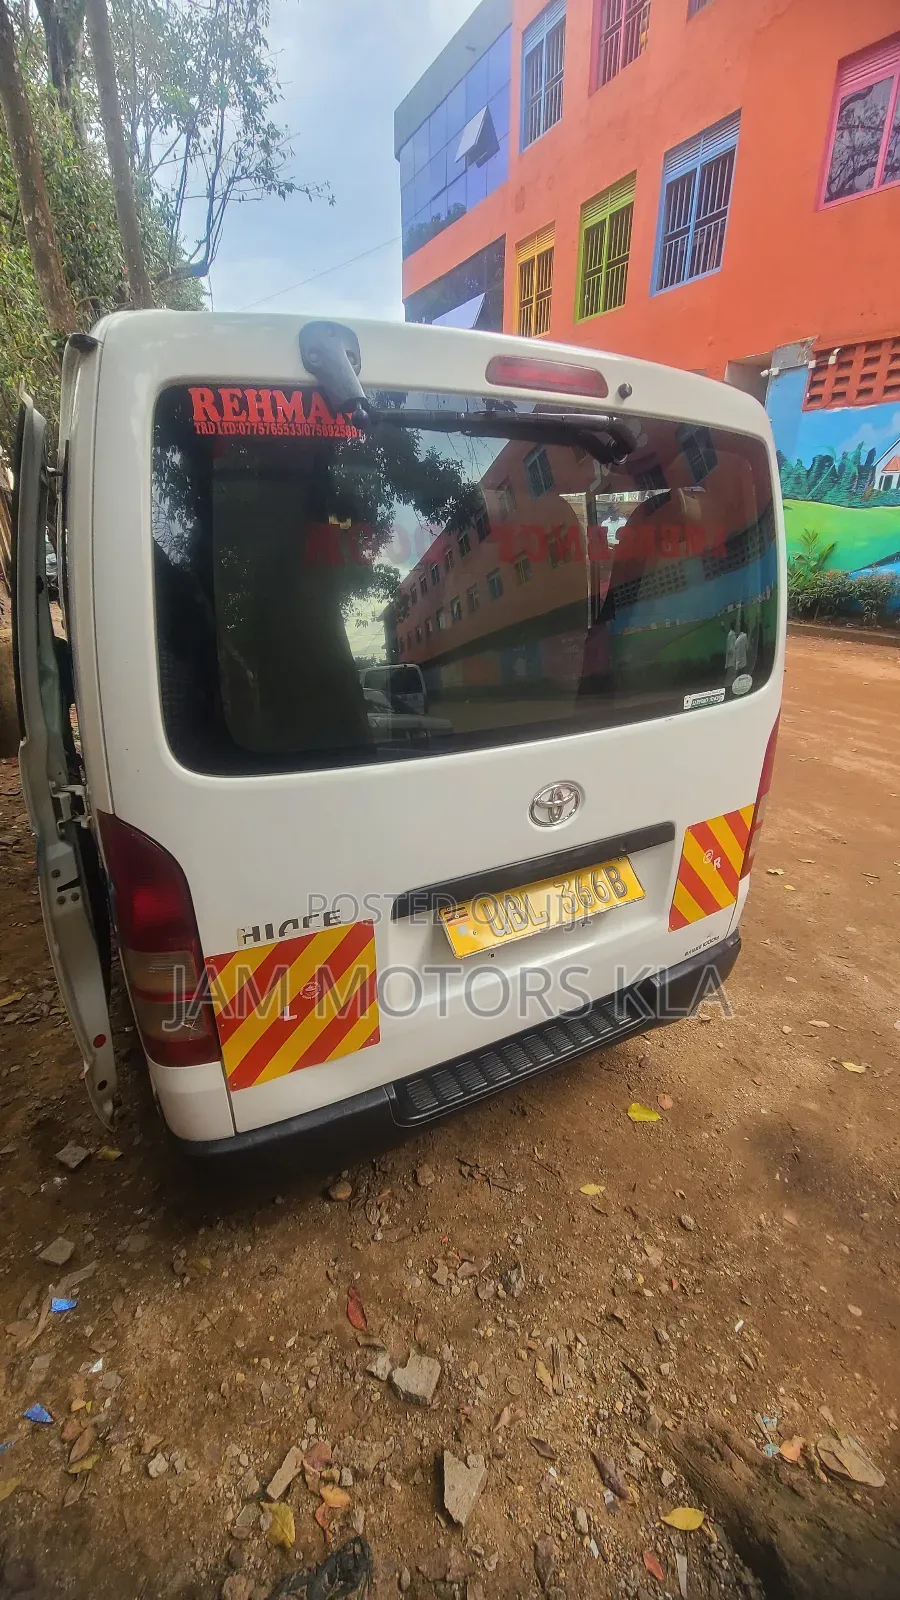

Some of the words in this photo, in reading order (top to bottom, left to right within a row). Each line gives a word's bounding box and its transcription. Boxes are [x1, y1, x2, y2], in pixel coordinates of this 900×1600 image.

[194, 421, 216, 435] TRD
[713, 856, 721, 871] R
[553, 865, 628, 914] 366B
[236, 909, 342, 947] HIACE
[284, 1005, 298, 1021] L
